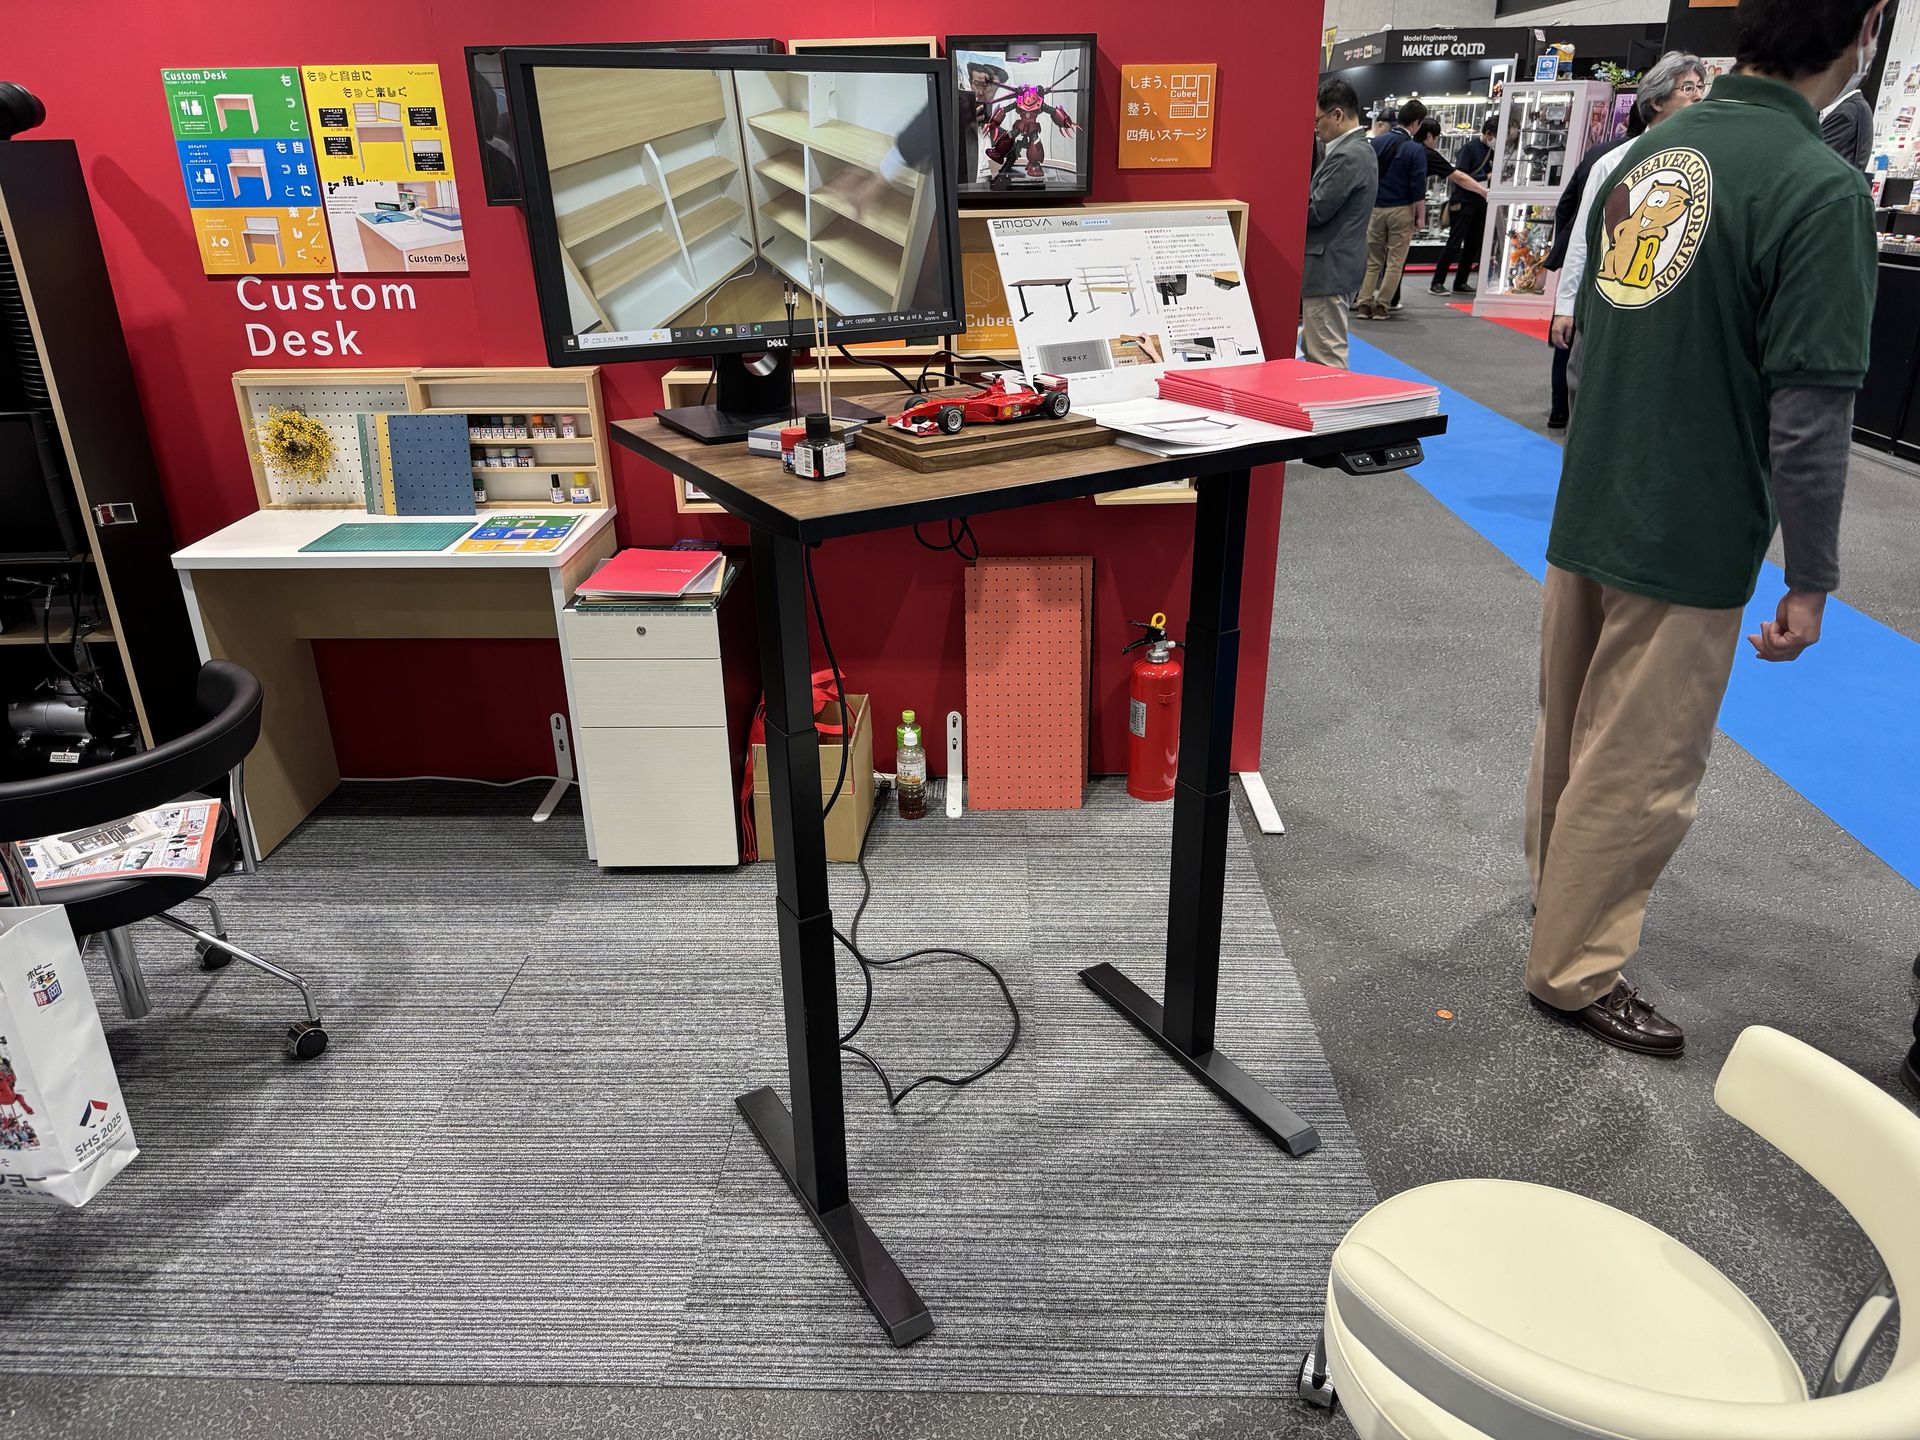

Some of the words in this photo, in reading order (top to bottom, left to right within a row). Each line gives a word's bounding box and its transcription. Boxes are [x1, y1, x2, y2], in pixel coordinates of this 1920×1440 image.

[1403, 34, 1422, 42] Model
[1423, 34, 1458, 43] Engineering
[1401, 44, 1433, 57] MAKE
[1434, 43, 1449, 56] UP
[163, 70, 201, 81] Custom
[203, 70, 228, 80] Desk
[1130, 75, 1168, 90] しまう、
[1170, 89, 1197, 98] Cubee
[280, 73, 301, 132] もっと
[1127, 101, 1158, 116] 整う、
[1126, 127, 1207, 142] 四角いステージ
[1631, 153, 1692, 186] BEAVER
[992, 217, 1053, 230] SMOOVA
[1061, 219, 1079, 227] Holis
[1656, 160, 1707, 293] CORPORATION
[408, 254, 442, 263] Custom
[444, 253, 467, 263] Desk
[1622, 235, 1661, 289] B
[236, 275, 417, 312] Custom
[966, 313, 1014, 328] Cubee
[245, 320, 364, 358] Desk
[766, 338, 788, 348] DELL
[27, 962, 53, 982] ホビー
[75, 1133, 100, 1157] SHS
[100, 1111, 122, 1139] 2025
